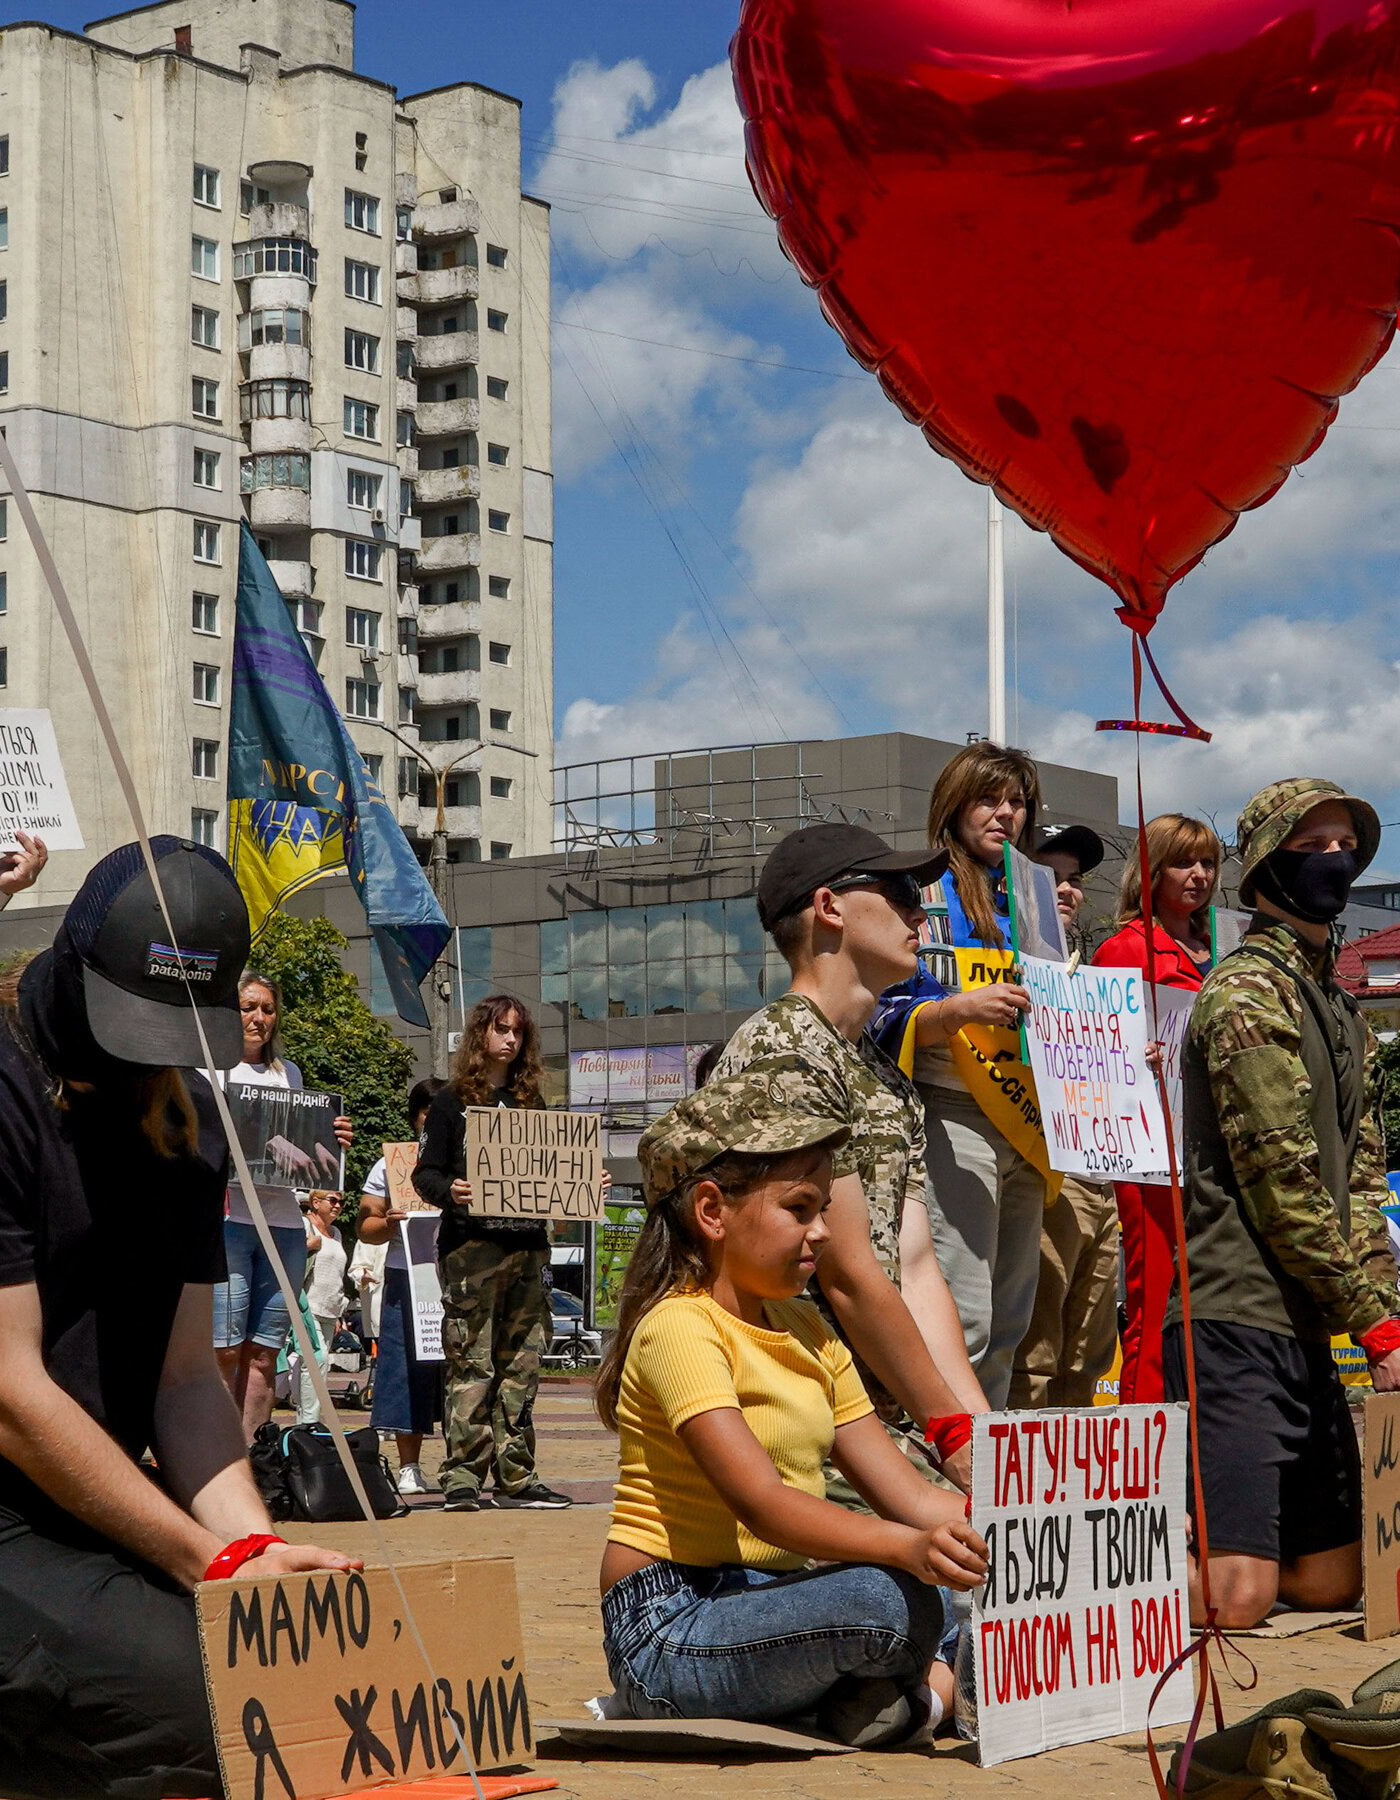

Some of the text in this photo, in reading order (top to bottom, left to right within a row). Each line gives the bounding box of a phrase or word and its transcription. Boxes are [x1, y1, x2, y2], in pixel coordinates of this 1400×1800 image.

[149, 962, 213, 982] patagonia
[1043, 1043, 1136, 1086] ПОВЕРНІТЬ
[240, 1085, 331, 1108] Де наші рідні!?
[1063, 1079, 1111, 1118] МЕНІ
[470, 1109, 599, 1149] ТИ ВІЛЬНИЙ
[477, 1146, 492, 1177] А
[1073, 1409, 1167, 1502] ЧУЄШ?
[981, 1501, 1172, 1609] Я БУДУ ТВОЇМ
[980, 1588, 1183, 1707] ГОЛОСОМ НА ВОЛІ
[241, 1655, 532, 1800] Я ЖИВИЙ
